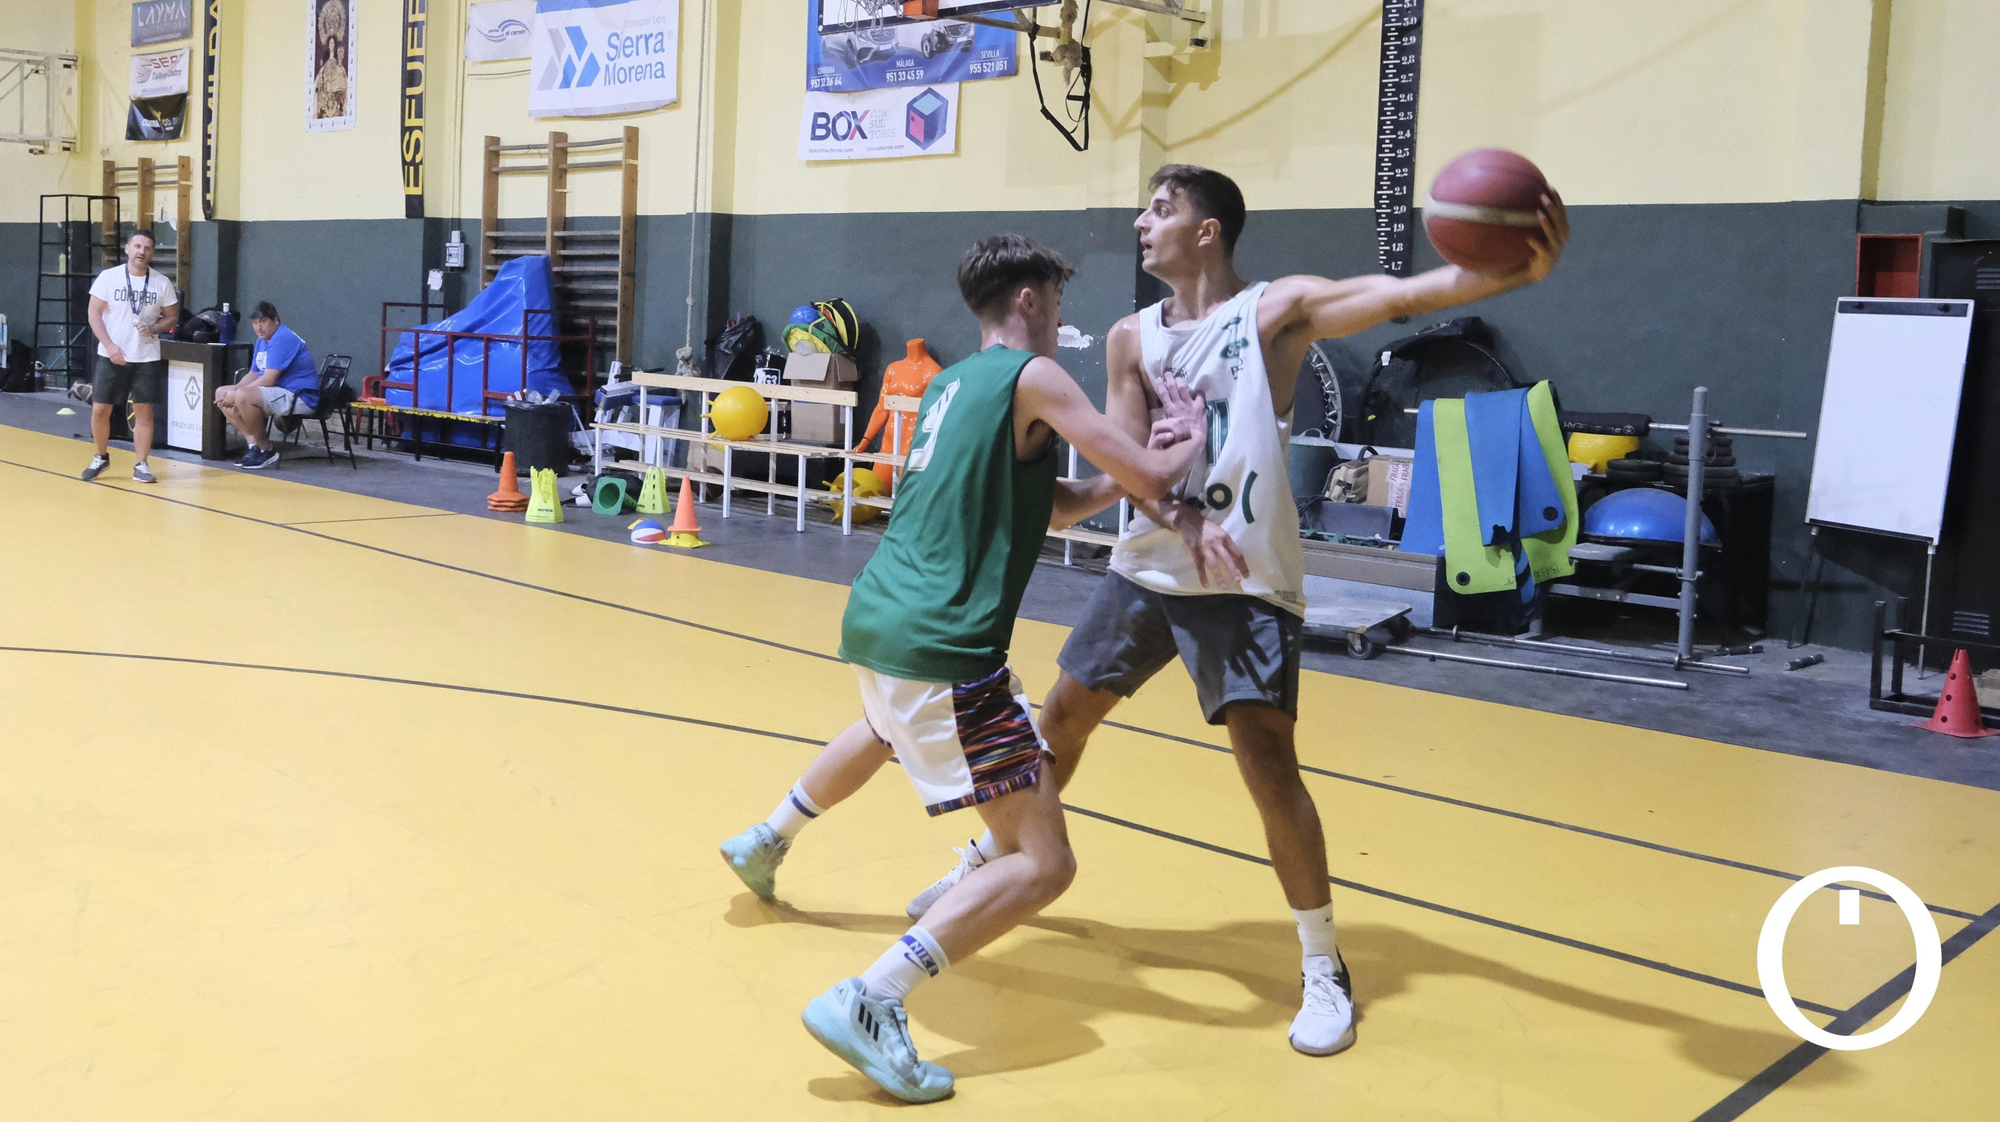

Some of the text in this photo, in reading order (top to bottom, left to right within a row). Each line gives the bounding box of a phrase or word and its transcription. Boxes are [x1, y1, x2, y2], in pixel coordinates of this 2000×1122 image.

[137, 0, 186, 27] LAYMA
[606, 31, 665, 62] Sierra
[980, 50, 1000, 59] SEVILLA
[604, 61, 666, 86] Morena
[886, 72, 897, 82] 951
[915, 69, 924, 80] 59
[969, 60, 1008, 74] 955 521 051
[810, 110, 869, 142] BOX
[869, 119, 886, 129] SUL
[870, 109, 887, 118] CON
[908, 378, 960, 472] 9
[911, 941, 940, 978] NIKE
